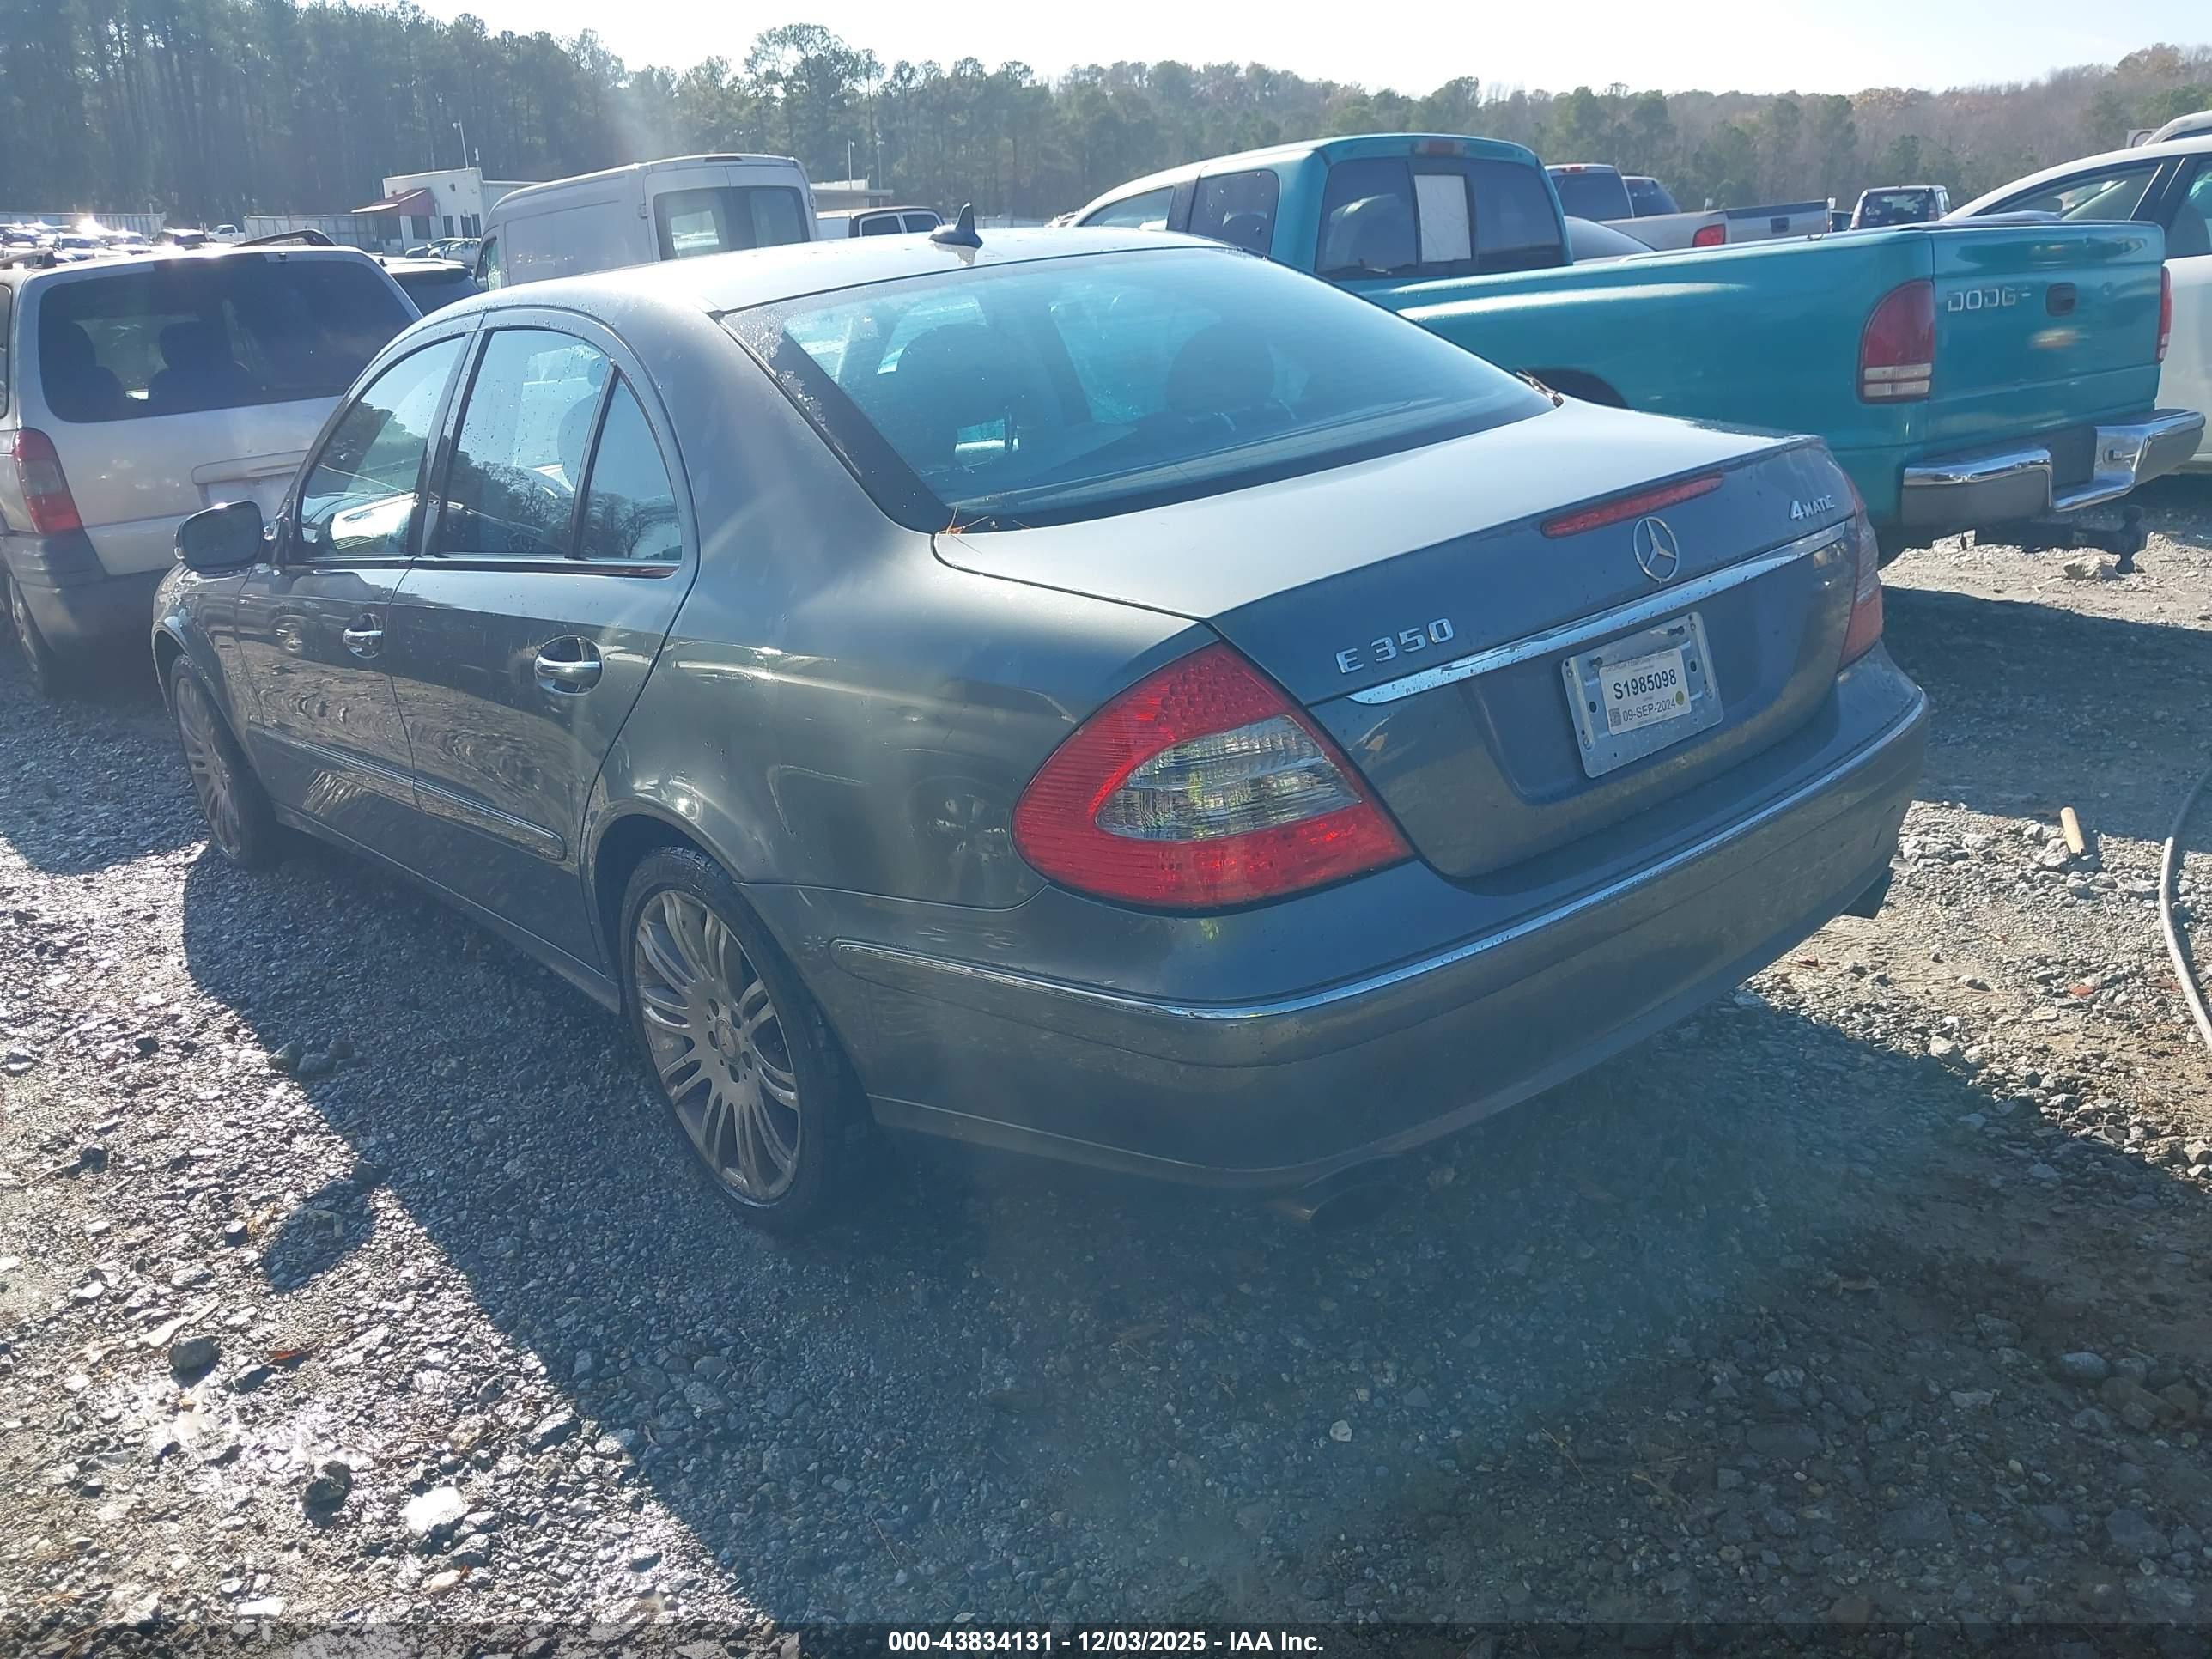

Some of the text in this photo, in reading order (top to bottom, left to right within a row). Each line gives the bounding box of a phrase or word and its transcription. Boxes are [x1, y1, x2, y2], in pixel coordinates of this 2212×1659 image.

[1335, 617, 1455, 675] E 350
[1613, 668, 1677, 701] S1985098
[1622, 697, 1676, 722] 09-SEP-2024
